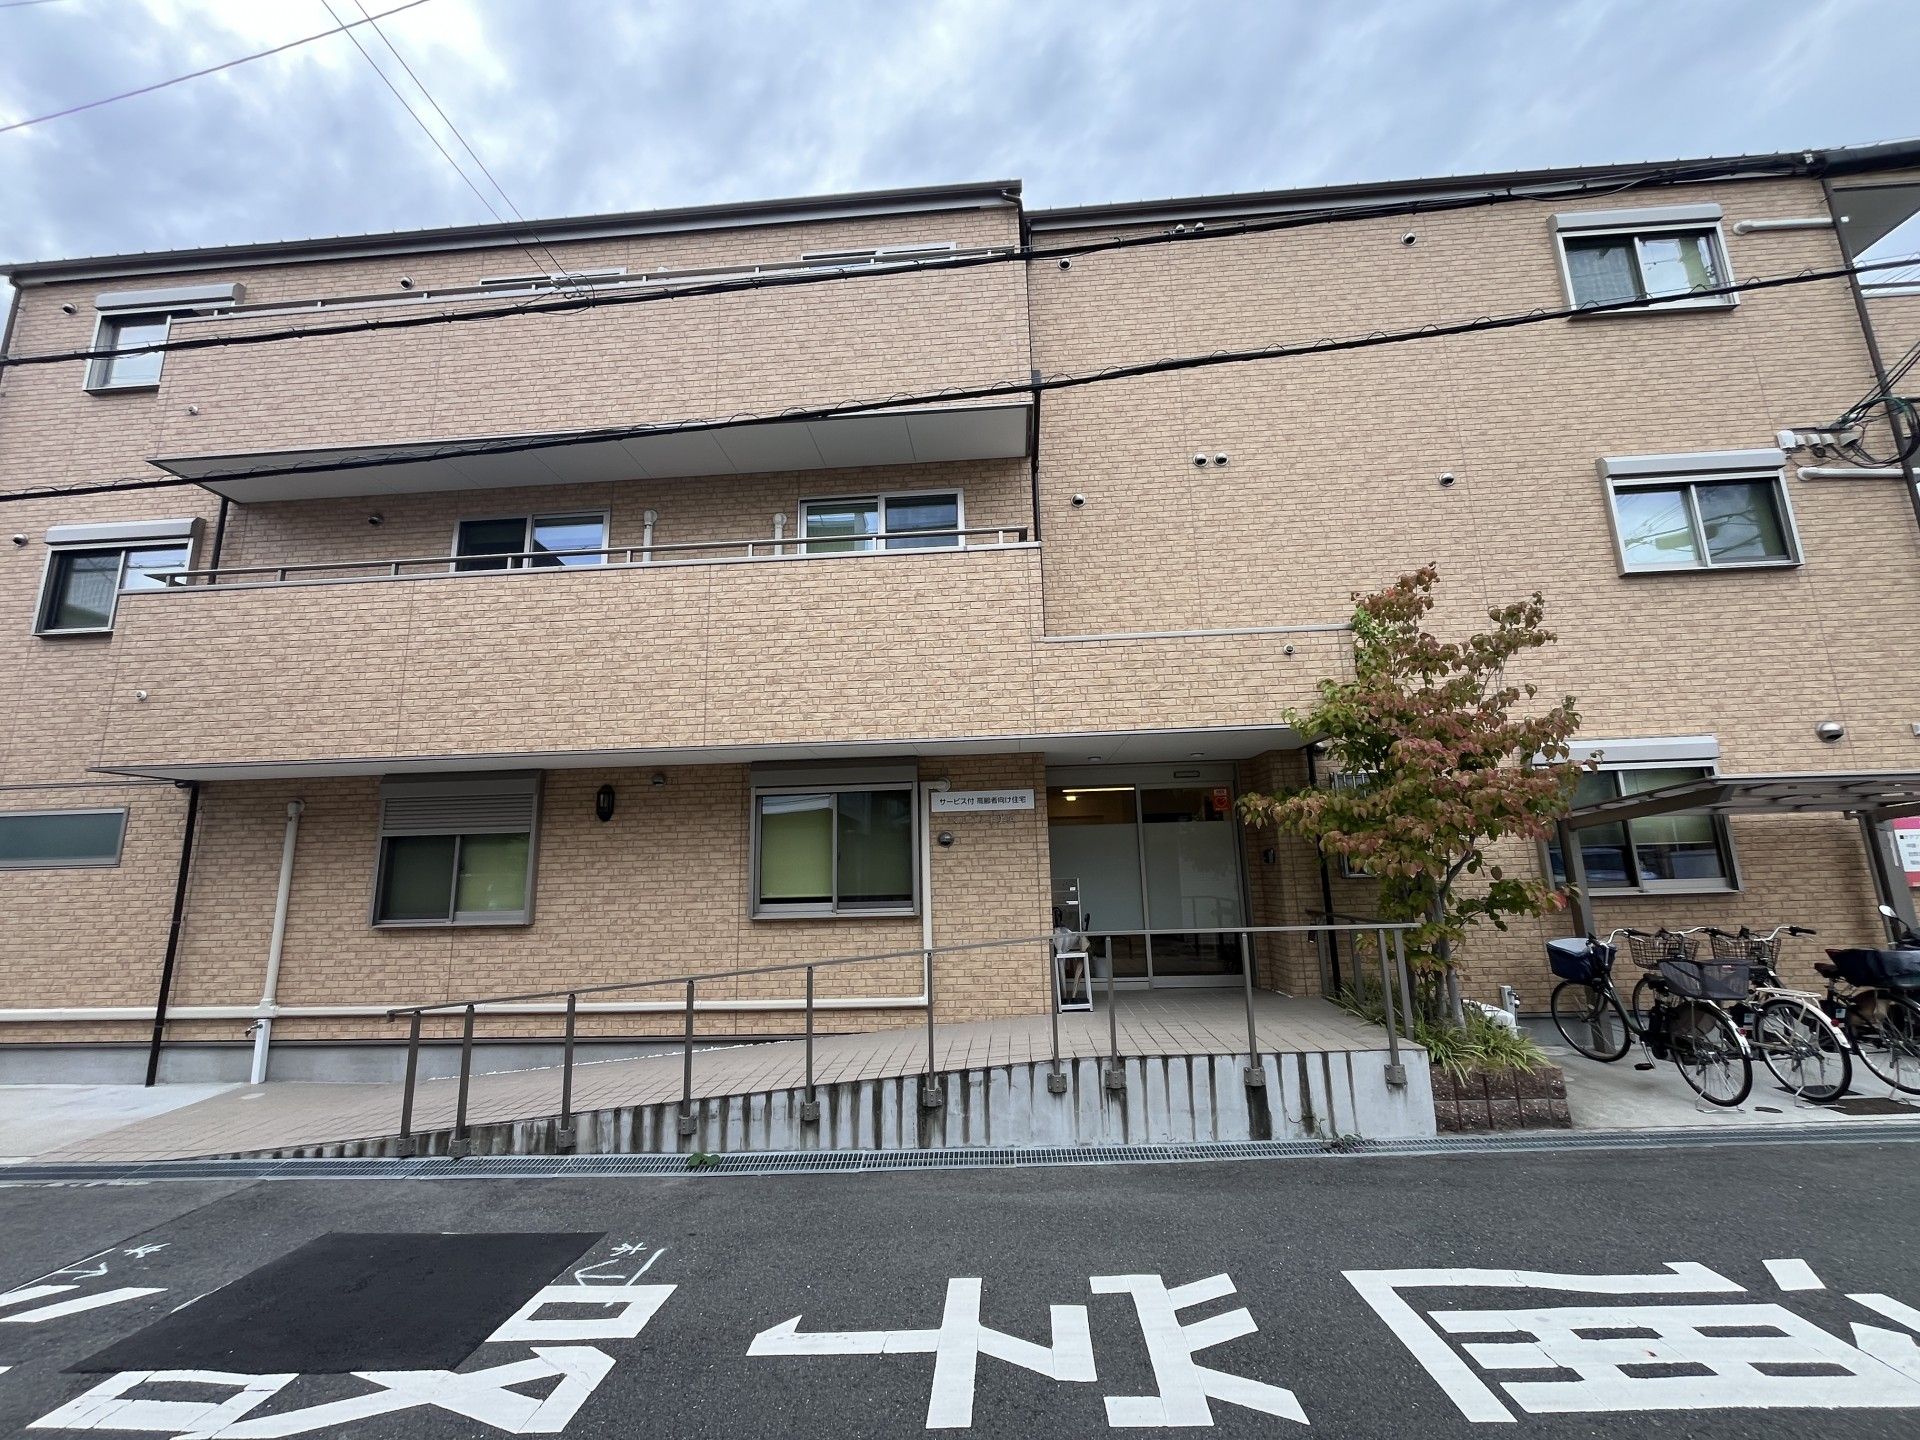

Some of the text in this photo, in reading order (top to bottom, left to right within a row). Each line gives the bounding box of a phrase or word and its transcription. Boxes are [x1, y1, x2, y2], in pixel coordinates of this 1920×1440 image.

[939, 795, 1027, 806] サービス付 高齢者向け住宅
[0, 1257, 1920, 1440] 通学路
